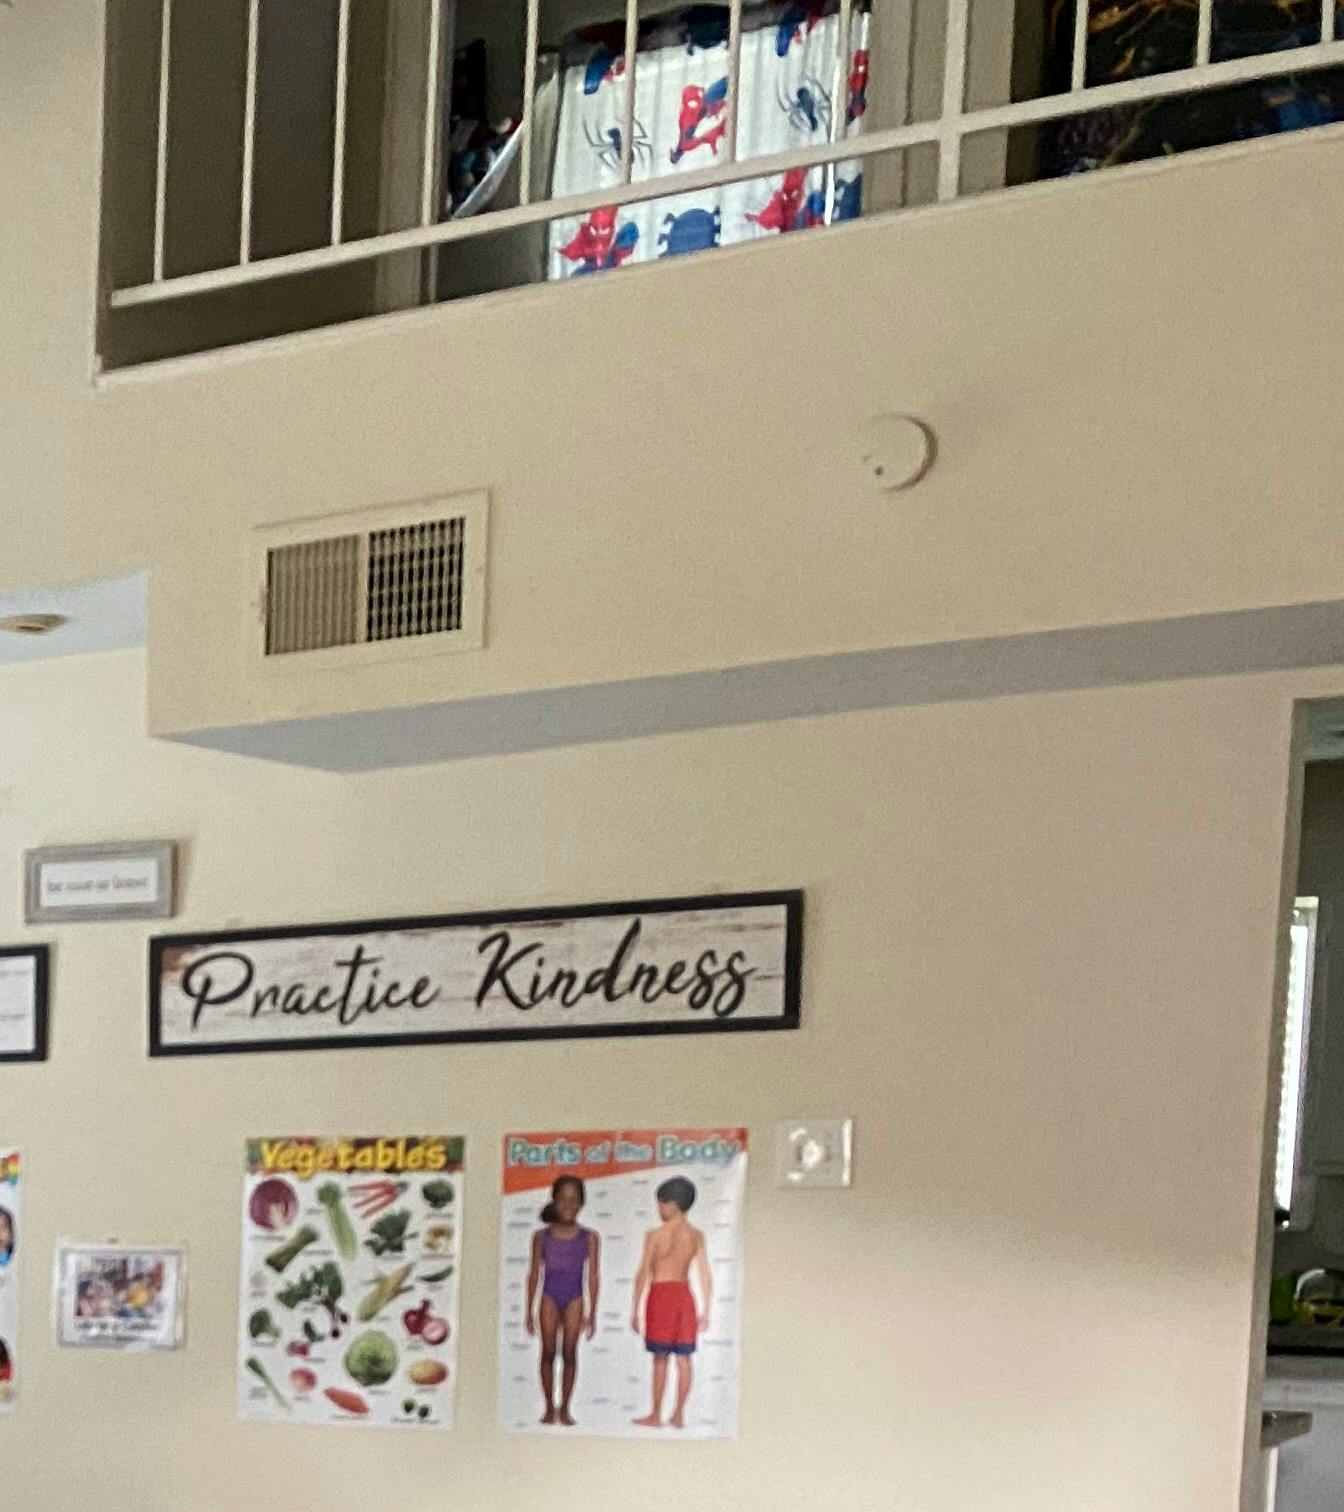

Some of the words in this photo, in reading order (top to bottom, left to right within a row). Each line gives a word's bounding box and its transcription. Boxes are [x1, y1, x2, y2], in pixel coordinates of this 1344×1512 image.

[181, 944, 440, 1030] Practice
[474, 917, 758, 1018] Kindness
[261, 1137, 448, 1181] Vegetables
[507, 1134, 582, 1167] Parts
[656, 1134, 741, 1167] Body
